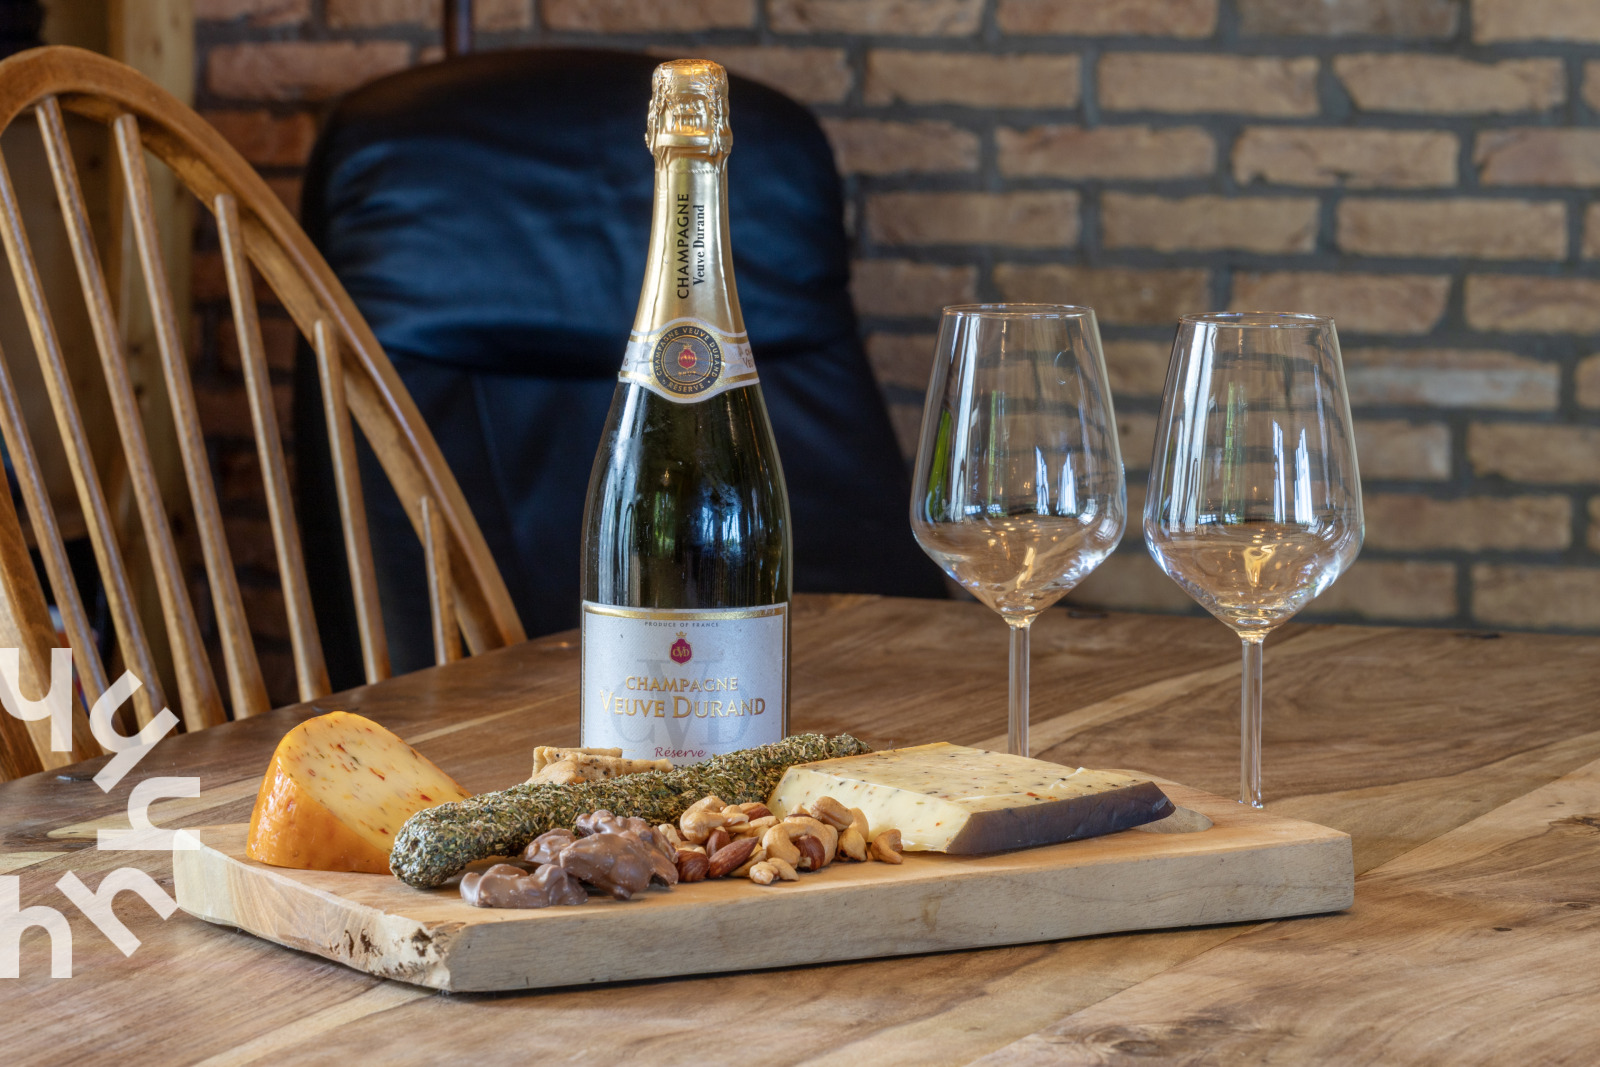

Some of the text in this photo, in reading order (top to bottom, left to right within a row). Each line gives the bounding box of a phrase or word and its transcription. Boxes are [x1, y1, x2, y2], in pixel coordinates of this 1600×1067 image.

[677, 193, 690, 299] CHAMPAGNE
[693, 204, 705, 286] Veuve Durand
[654, 327, 721, 378] CHAMPAGNE VEUVE DURAND
[599, 689, 766, 718] VEUVE DURAND
[625, 675, 738, 692] CHAMPAGNE
[654, 746, 706, 759] Réserve
